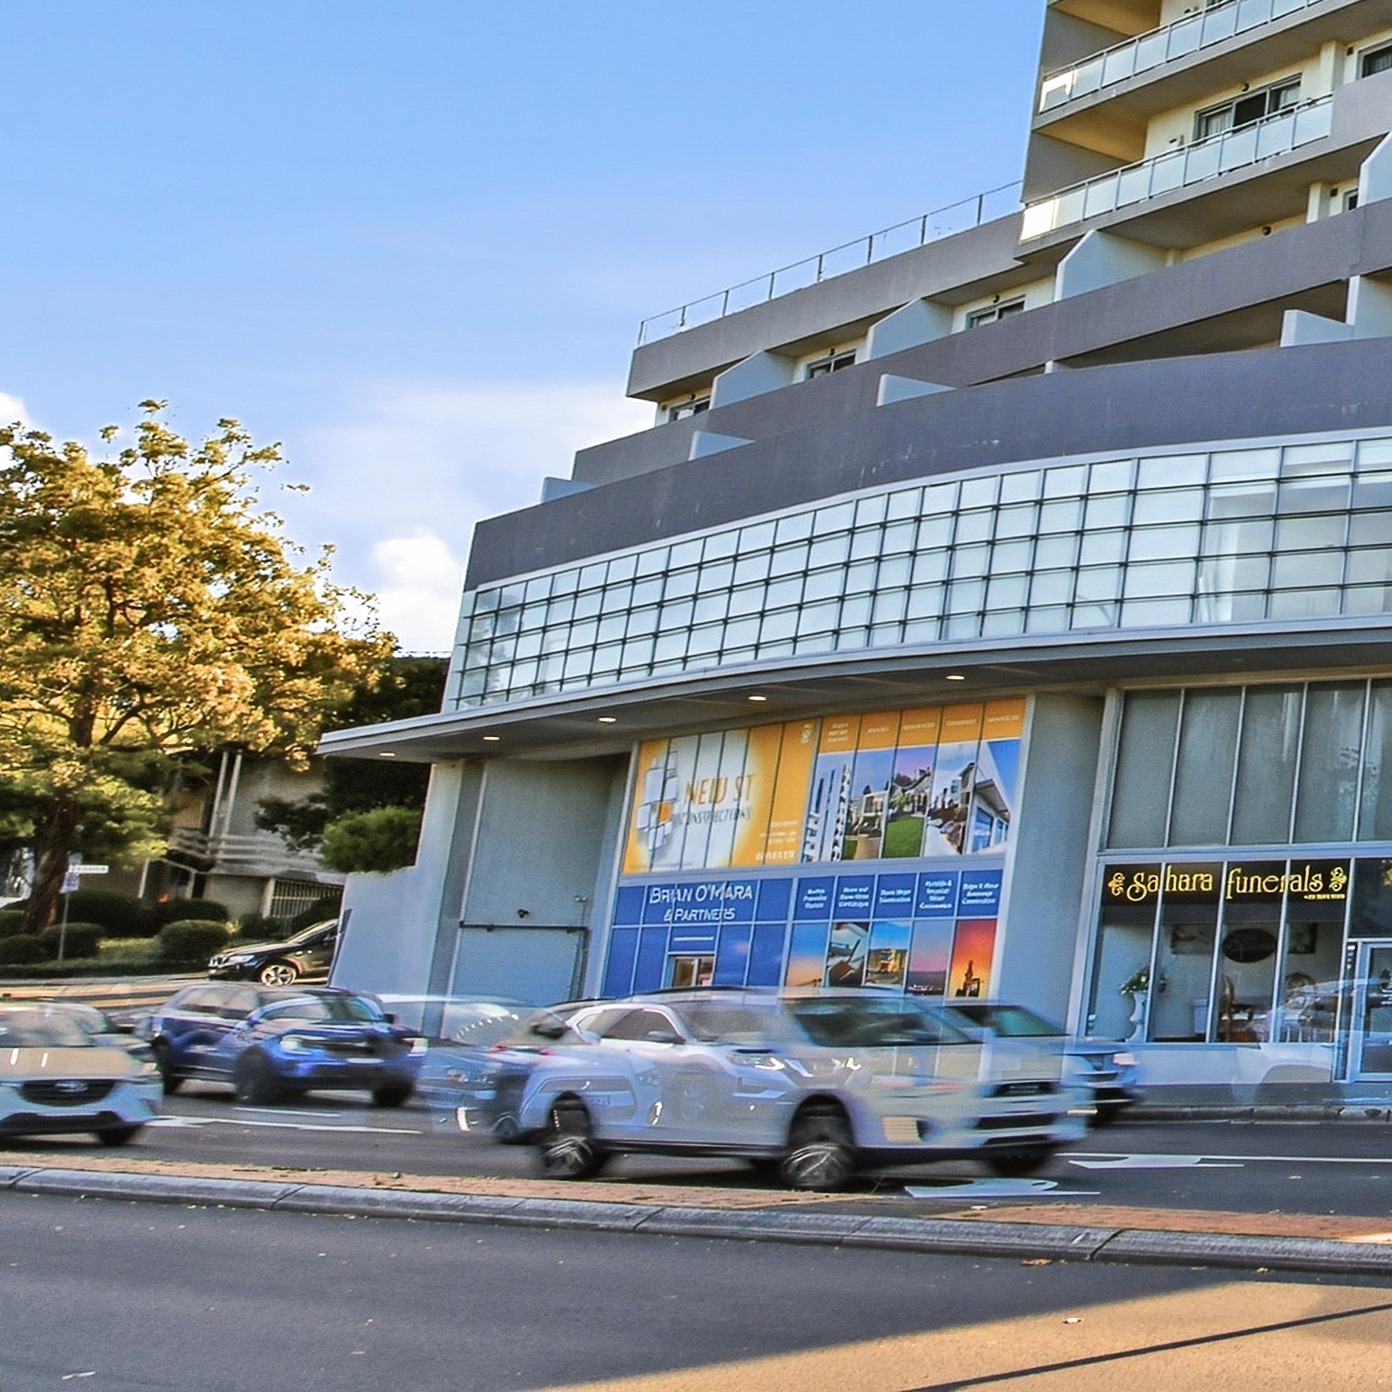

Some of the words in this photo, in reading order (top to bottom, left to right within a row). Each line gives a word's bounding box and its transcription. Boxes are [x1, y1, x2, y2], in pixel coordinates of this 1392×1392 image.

[649, 886, 693, 905] BRIAN
[694, 883, 754, 903] O'MARA
[1126, 864, 1214, 902] Sahara
[1225, 865, 1324, 900] funerals
[673, 907, 736, 922] PARTNERS
